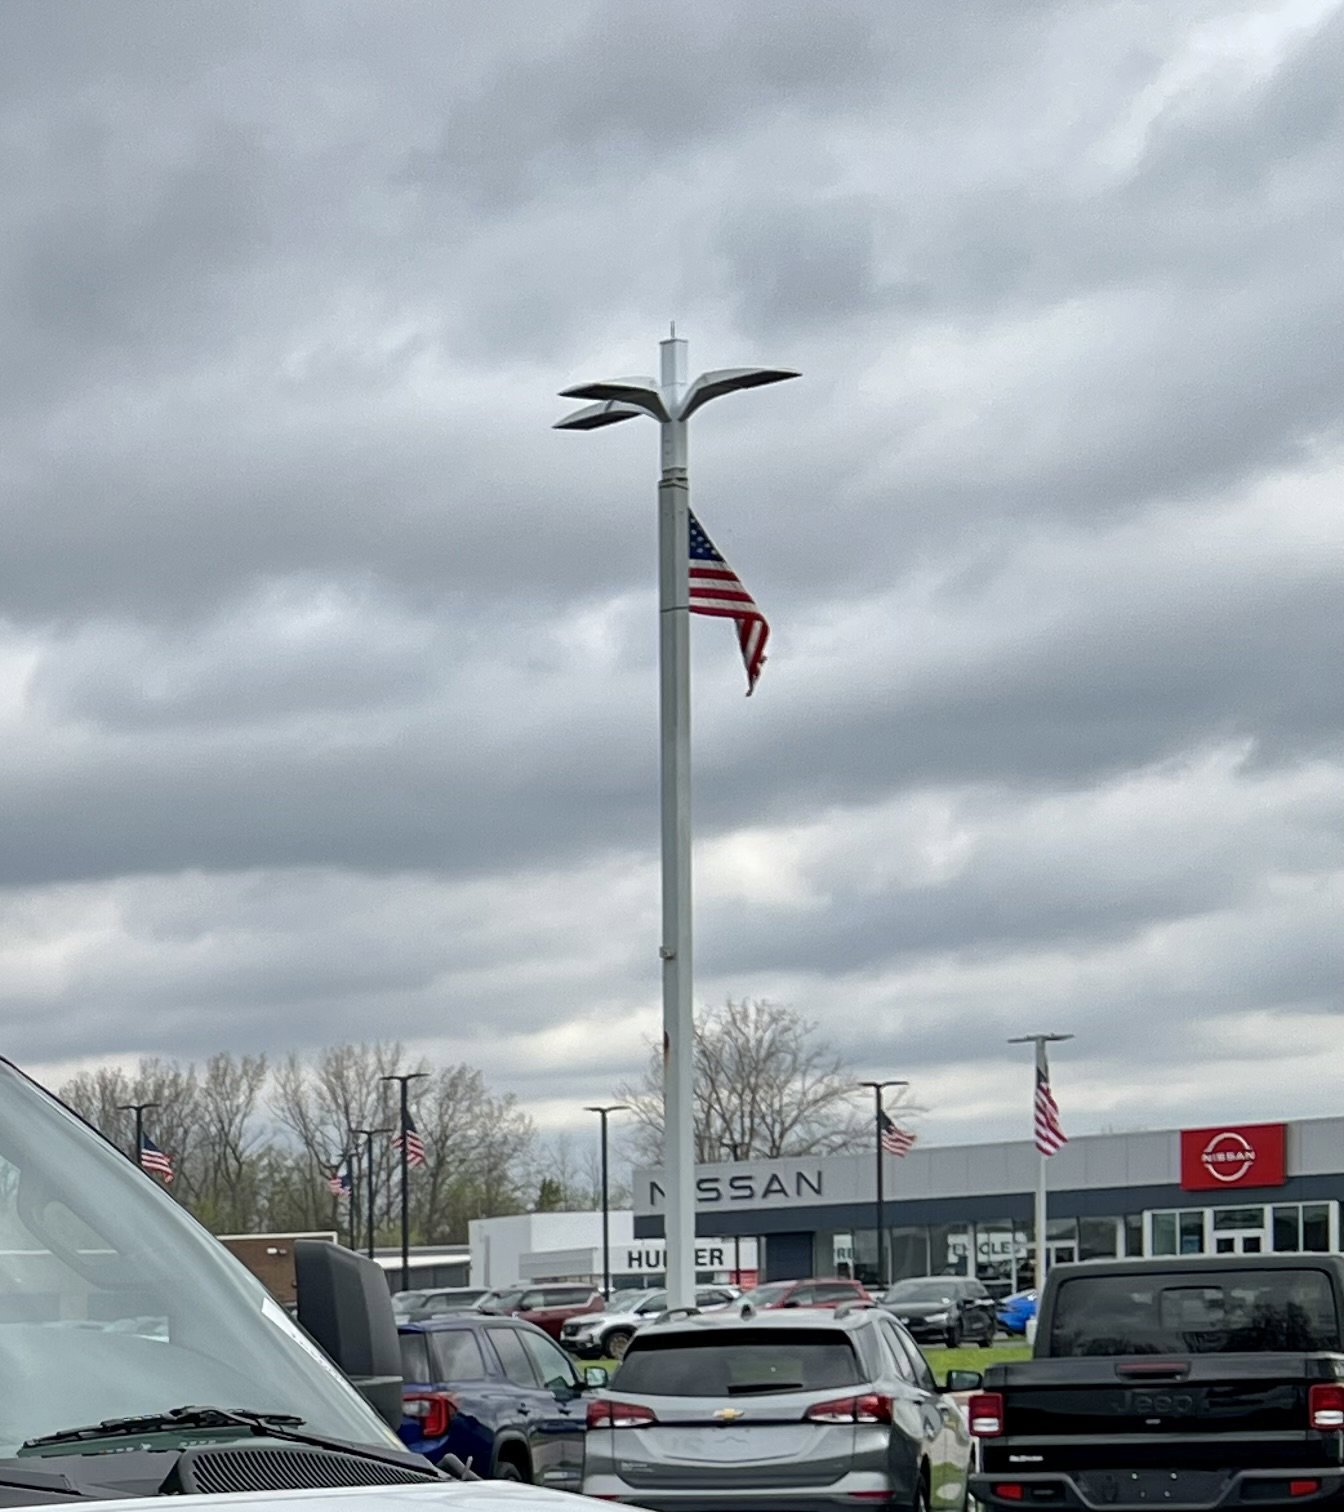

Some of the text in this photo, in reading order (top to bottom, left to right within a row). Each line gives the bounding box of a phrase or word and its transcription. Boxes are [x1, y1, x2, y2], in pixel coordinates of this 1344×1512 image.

[1200, 1151, 1256, 1162] NISSAN
[649, 1170, 823, 1206] NSSAN
[628, 1248, 724, 1269] HUER
